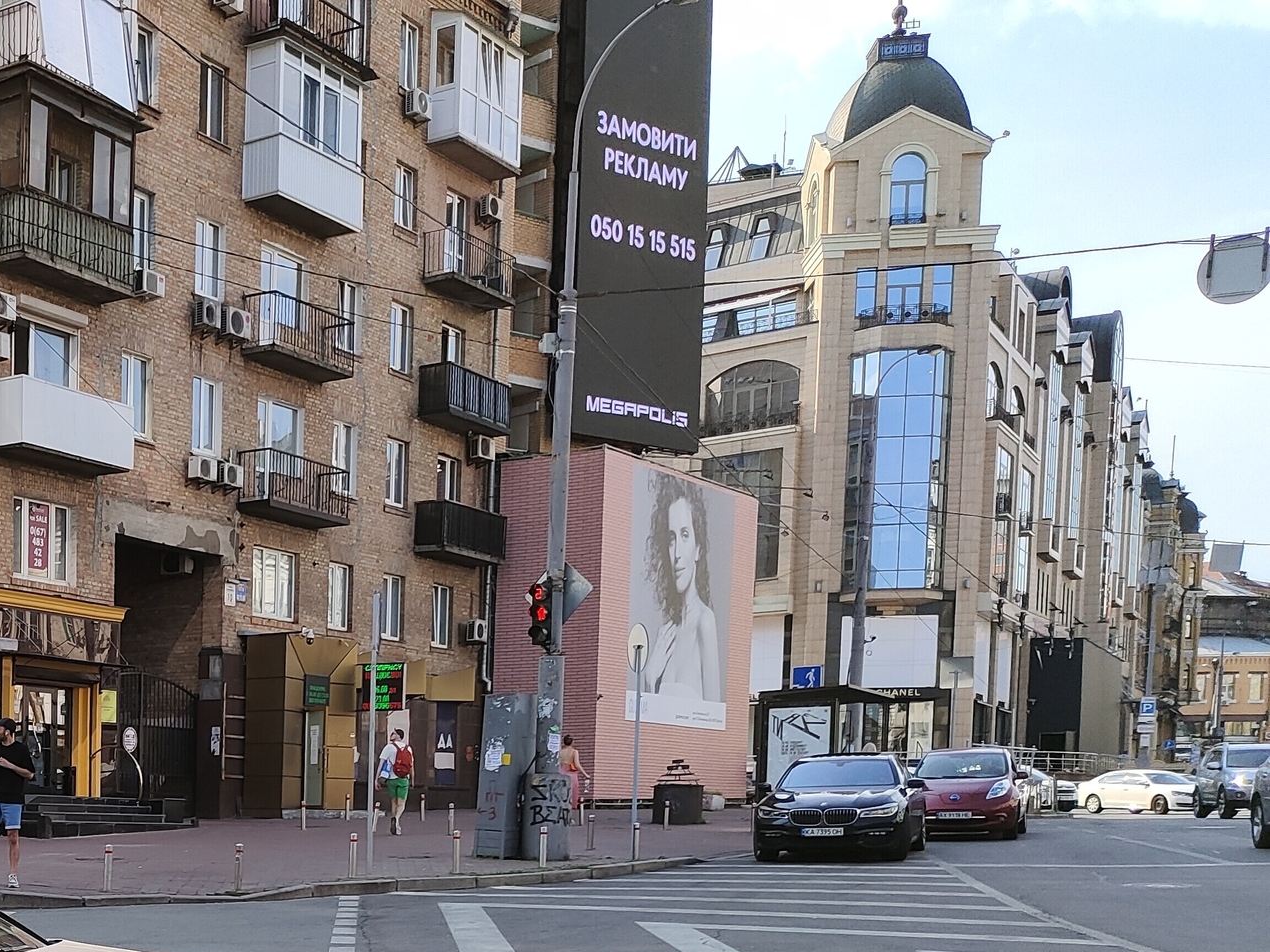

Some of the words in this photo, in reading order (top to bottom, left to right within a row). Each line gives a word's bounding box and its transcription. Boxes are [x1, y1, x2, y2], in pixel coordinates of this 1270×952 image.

[596, 109, 698, 161] ЗАМОВИТИ
[603, 146, 689, 191] РЕКЛАМУ
[590, 213, 623, 243] 050
[627, 223, 645, 249] 15
[649, 229, 666, 254] 15
[669, 234, 697, 262] 515
[33, 547, 43, 557] 42
[33, 558, 43, 567] 28
